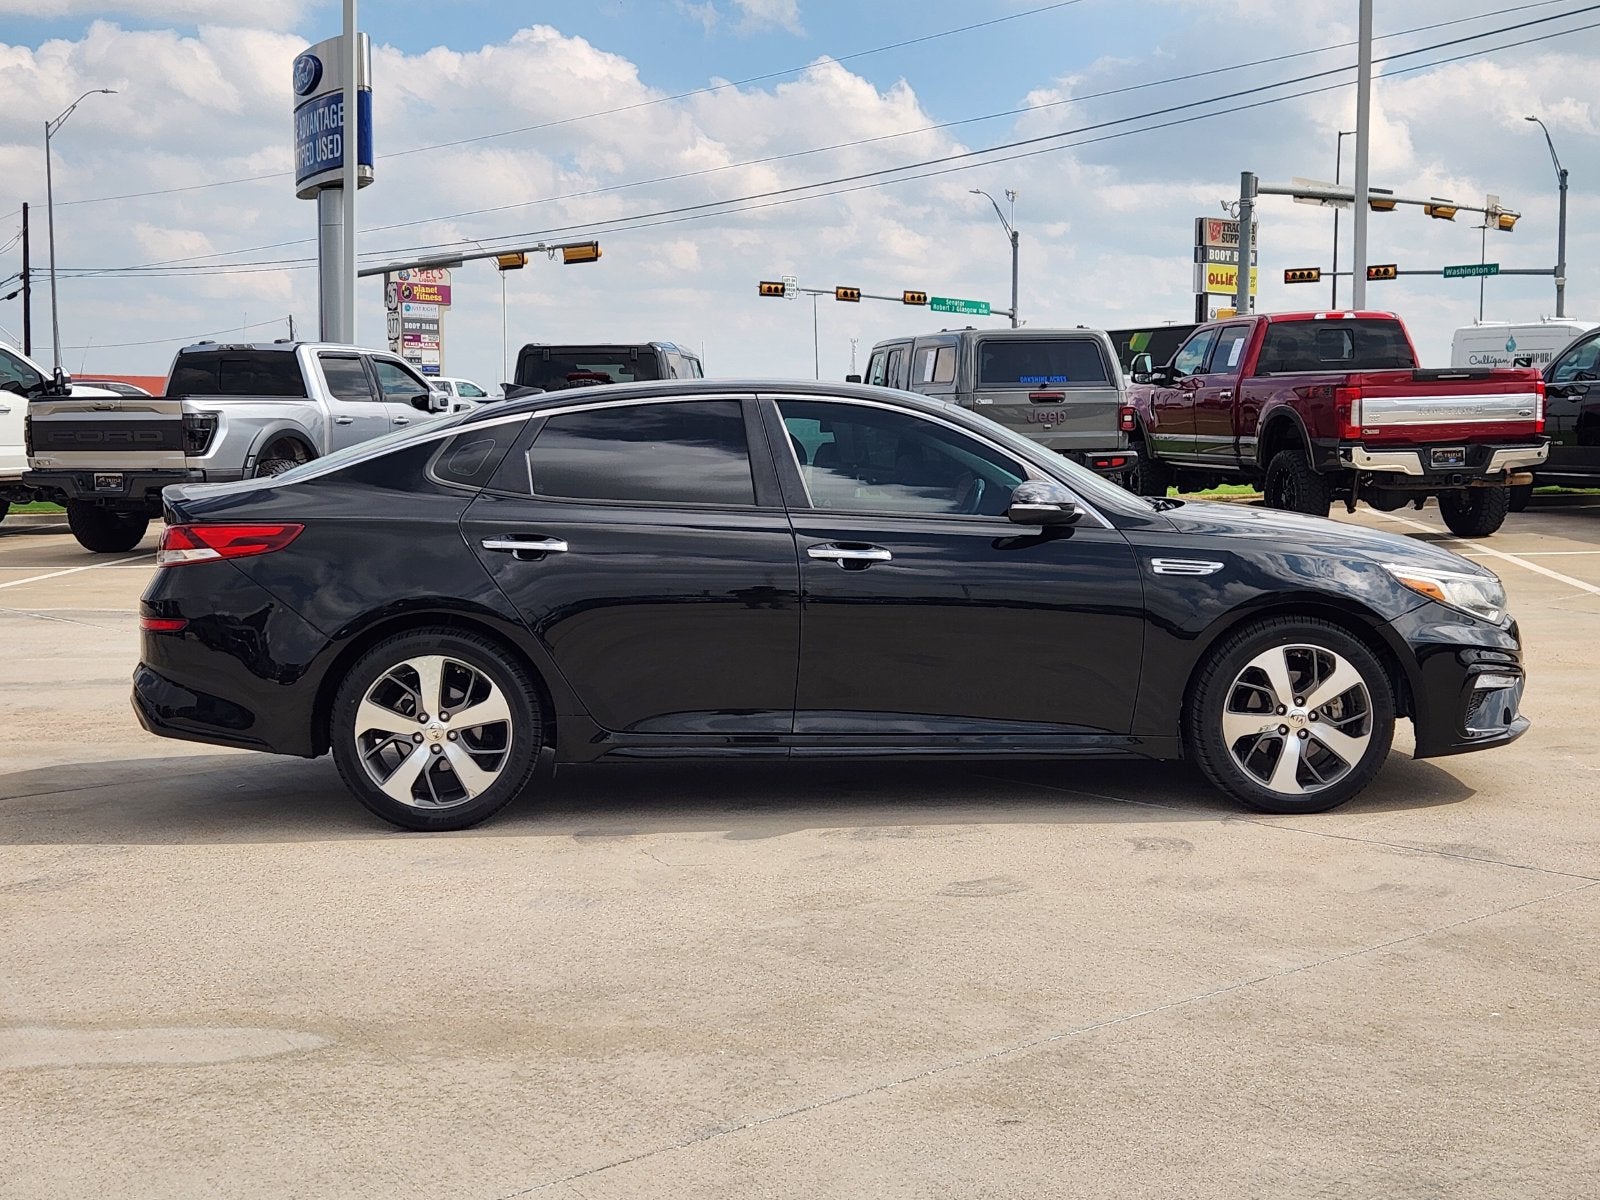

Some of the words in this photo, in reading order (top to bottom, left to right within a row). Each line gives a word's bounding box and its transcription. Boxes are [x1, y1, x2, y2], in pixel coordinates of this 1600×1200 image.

[316, 134, 342, 162] USED
[1209, 249, 1231, 261] BOOT
[1446, 266, 1488, 276] Washington
[413, 285, 438, 295] planet
[415, 293, 443, 302] fitness
[932, 303, 950, 311] Robert
[956, 305, 977, 315] Glasgow
[1469, 353, 1511, 367] Culligan
[1027, 409, 1067, 425] Jeep
[49, 431, 163, 442] FORD
[1290, 713, 1304, 725] KIA
